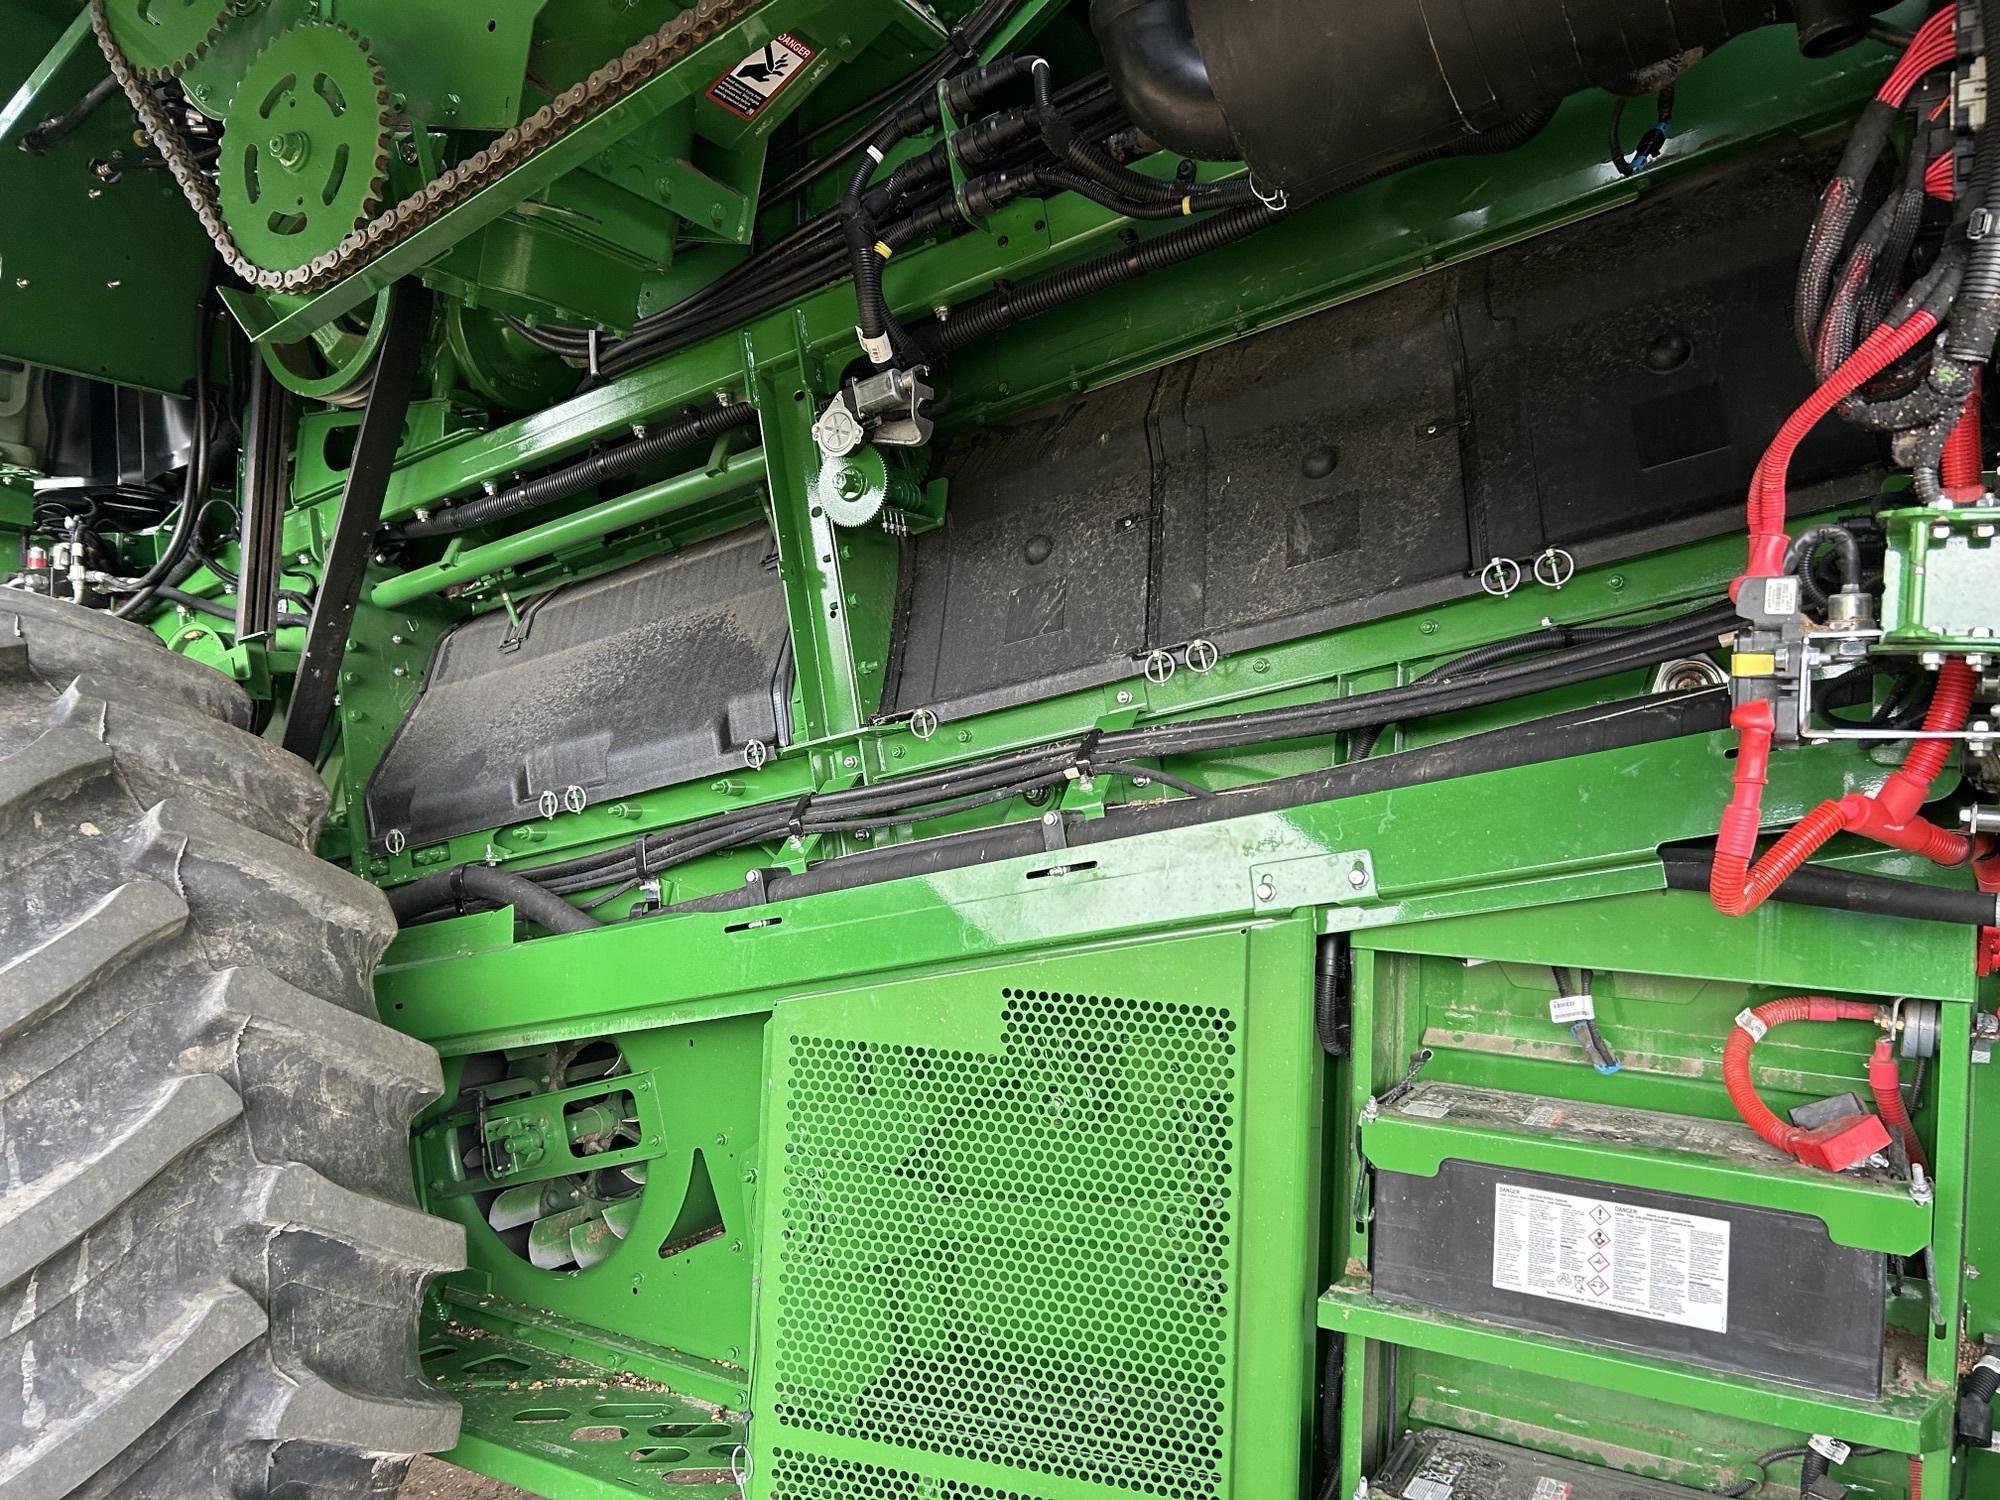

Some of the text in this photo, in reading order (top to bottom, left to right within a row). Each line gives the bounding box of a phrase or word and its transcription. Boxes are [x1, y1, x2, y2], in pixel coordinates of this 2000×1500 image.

[777, 33, 812, 58] DANGER
[1499, 1187, 1520, 1195] DANGER
[1615, 1206, 1638, 1215] DANGER
